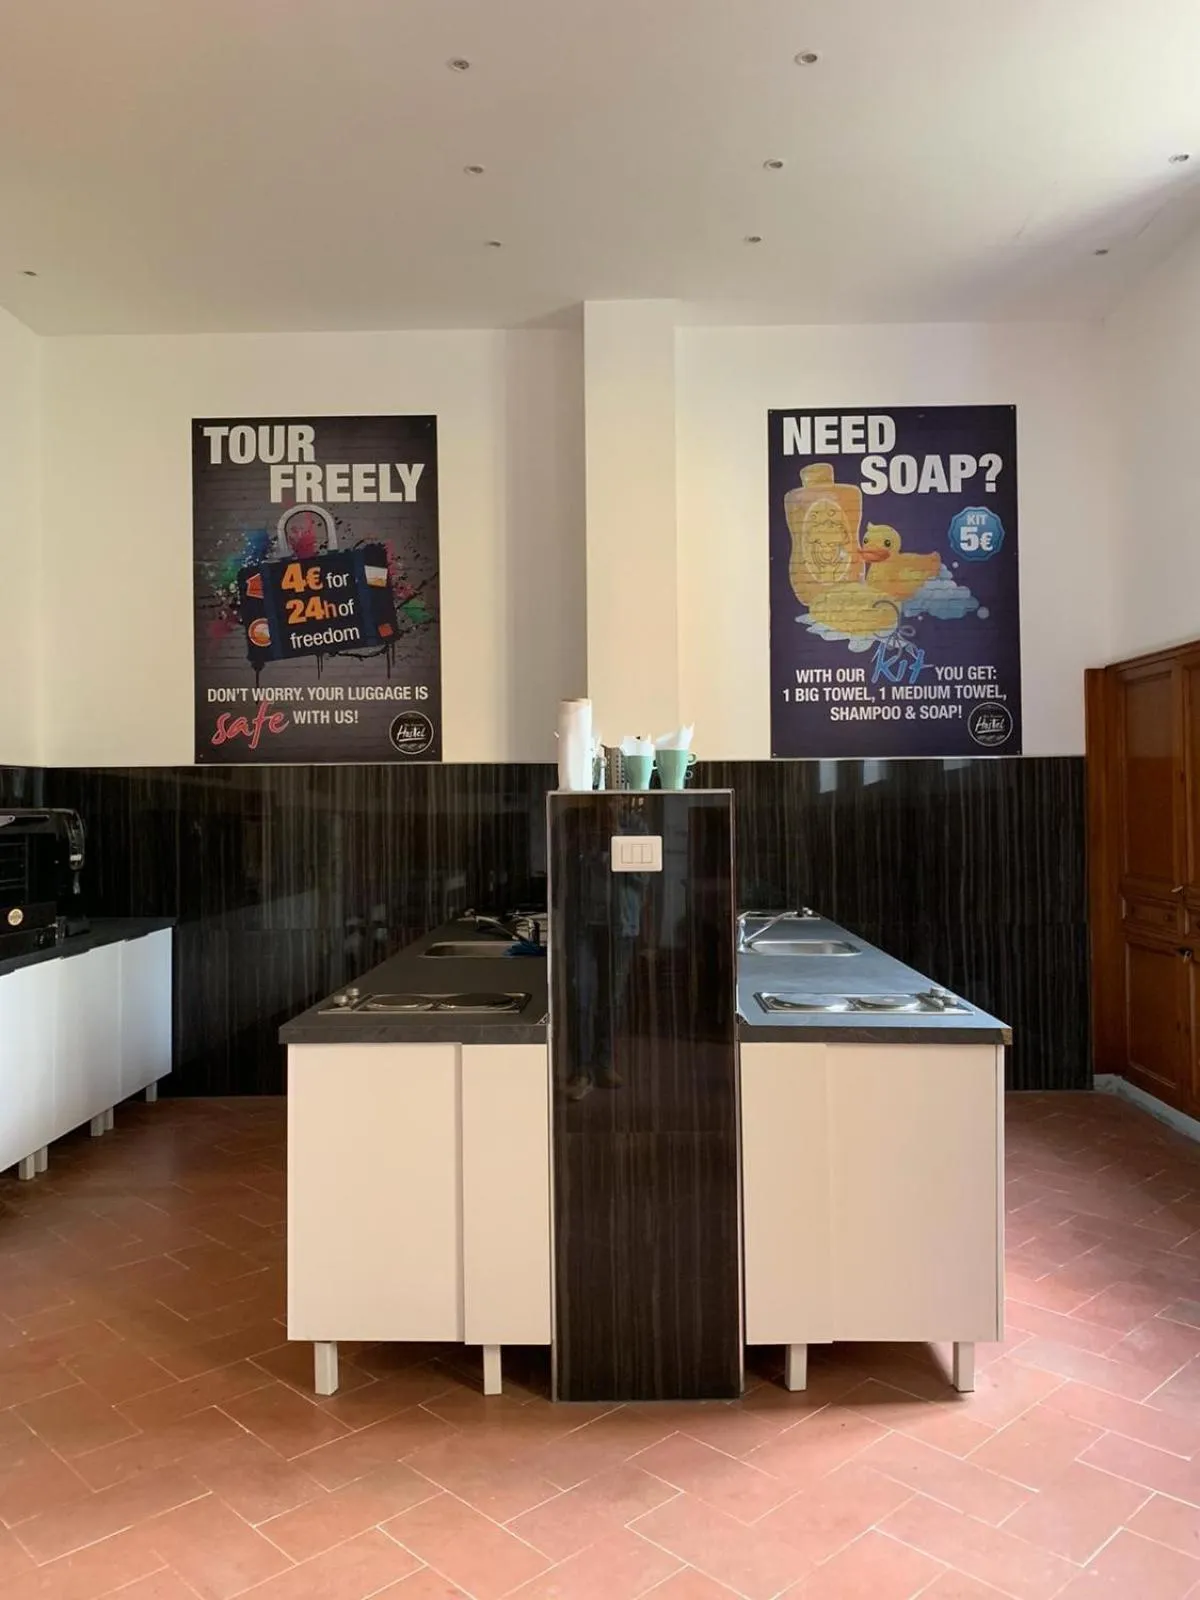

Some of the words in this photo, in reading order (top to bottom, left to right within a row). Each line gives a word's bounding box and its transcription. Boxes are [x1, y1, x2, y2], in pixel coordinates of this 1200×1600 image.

[203, 425, 315, 464] TOUR
[783, 415, 896, 456] NEED
[270, 463, 425, 503] FREELY
[860, 453, 1003, 495] SOAP?
[966, 514, 988, 525] KIT
[959, 526, 993, 551] 5€
[281, 563, 324, 593] 4€
[326, 572, 350, 589] for
[285, 596, 338, 625] 24h
[339, 599, 355, 616] of
[289, 624, 361, 649] freedom
[796, 669, 832, 684] WITH
[836, 668, 865, 683] OUR
[935, 666, 965, 681] YOU
[967, 665, 997, 680] GET:
[207, 687, 249, 703] DON'T
[252, 687, 304, 702] WORRY.
[308, 686, 344, 701] YOUR
[348, 686, 412, 701] LUGGAGE
[415, 686, 429, 700] IS
[782, 689, 789, 702] 1
[795, 688, 819, 702] BIG
[823, 687, 876, 703] TOWEL,
[879, 687, 886, 700] 1
[891, 685, 950, 701] MEDIUM
[954, 684, 1007, 701] TOWEL,
[211, 699, 290, 749] safe
[292, 710, 330, 725] WITH
[334, 709, 359, 724] US!
[830, 706, 901, 721] SHAMPOO
[905, 706, 917, 720] &
[919, 705, 962, 720] SOAP!
